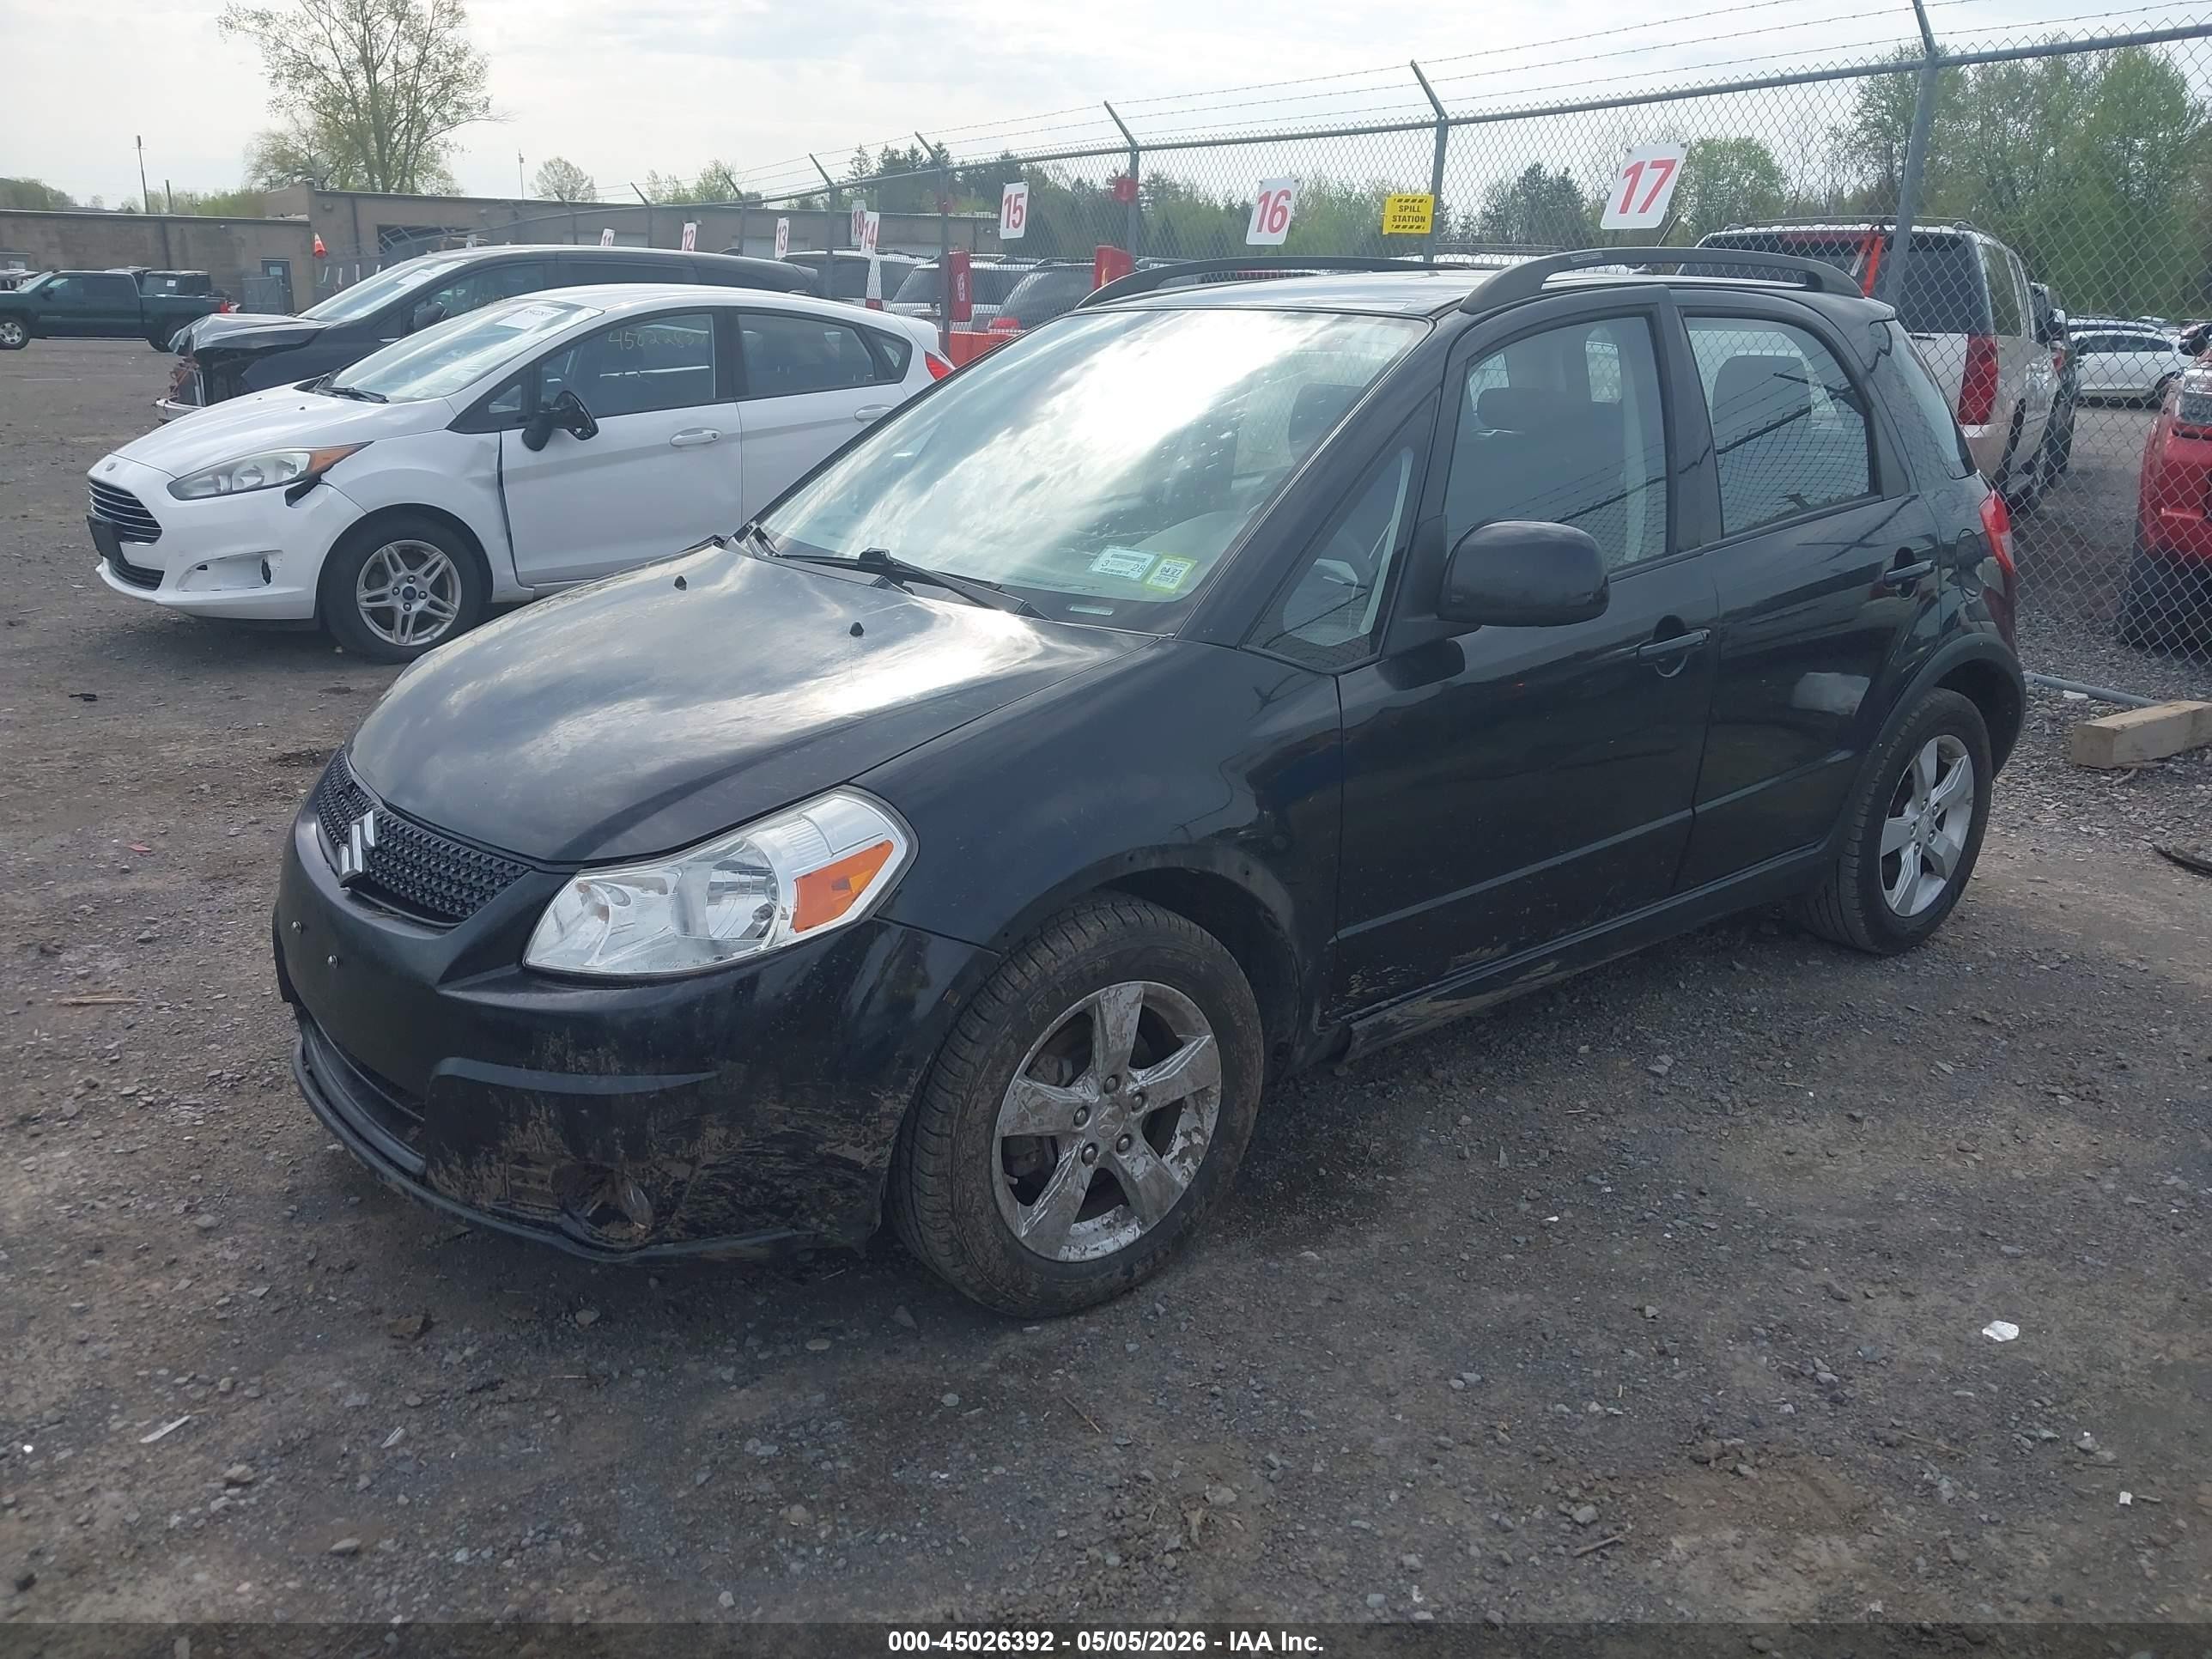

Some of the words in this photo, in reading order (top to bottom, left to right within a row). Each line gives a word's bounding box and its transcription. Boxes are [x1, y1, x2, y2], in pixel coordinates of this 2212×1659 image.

[1619, 159, 1677, 214] 17
[1004, 192, 1024, 229] 15
[1256, 190, 1291, 234] 16
[684, 229, 695, 251] 12
[776, 225, 787, 251] 13
[865, 220, 876, 250] 14
[1130, 563, 1146, 573] 28
